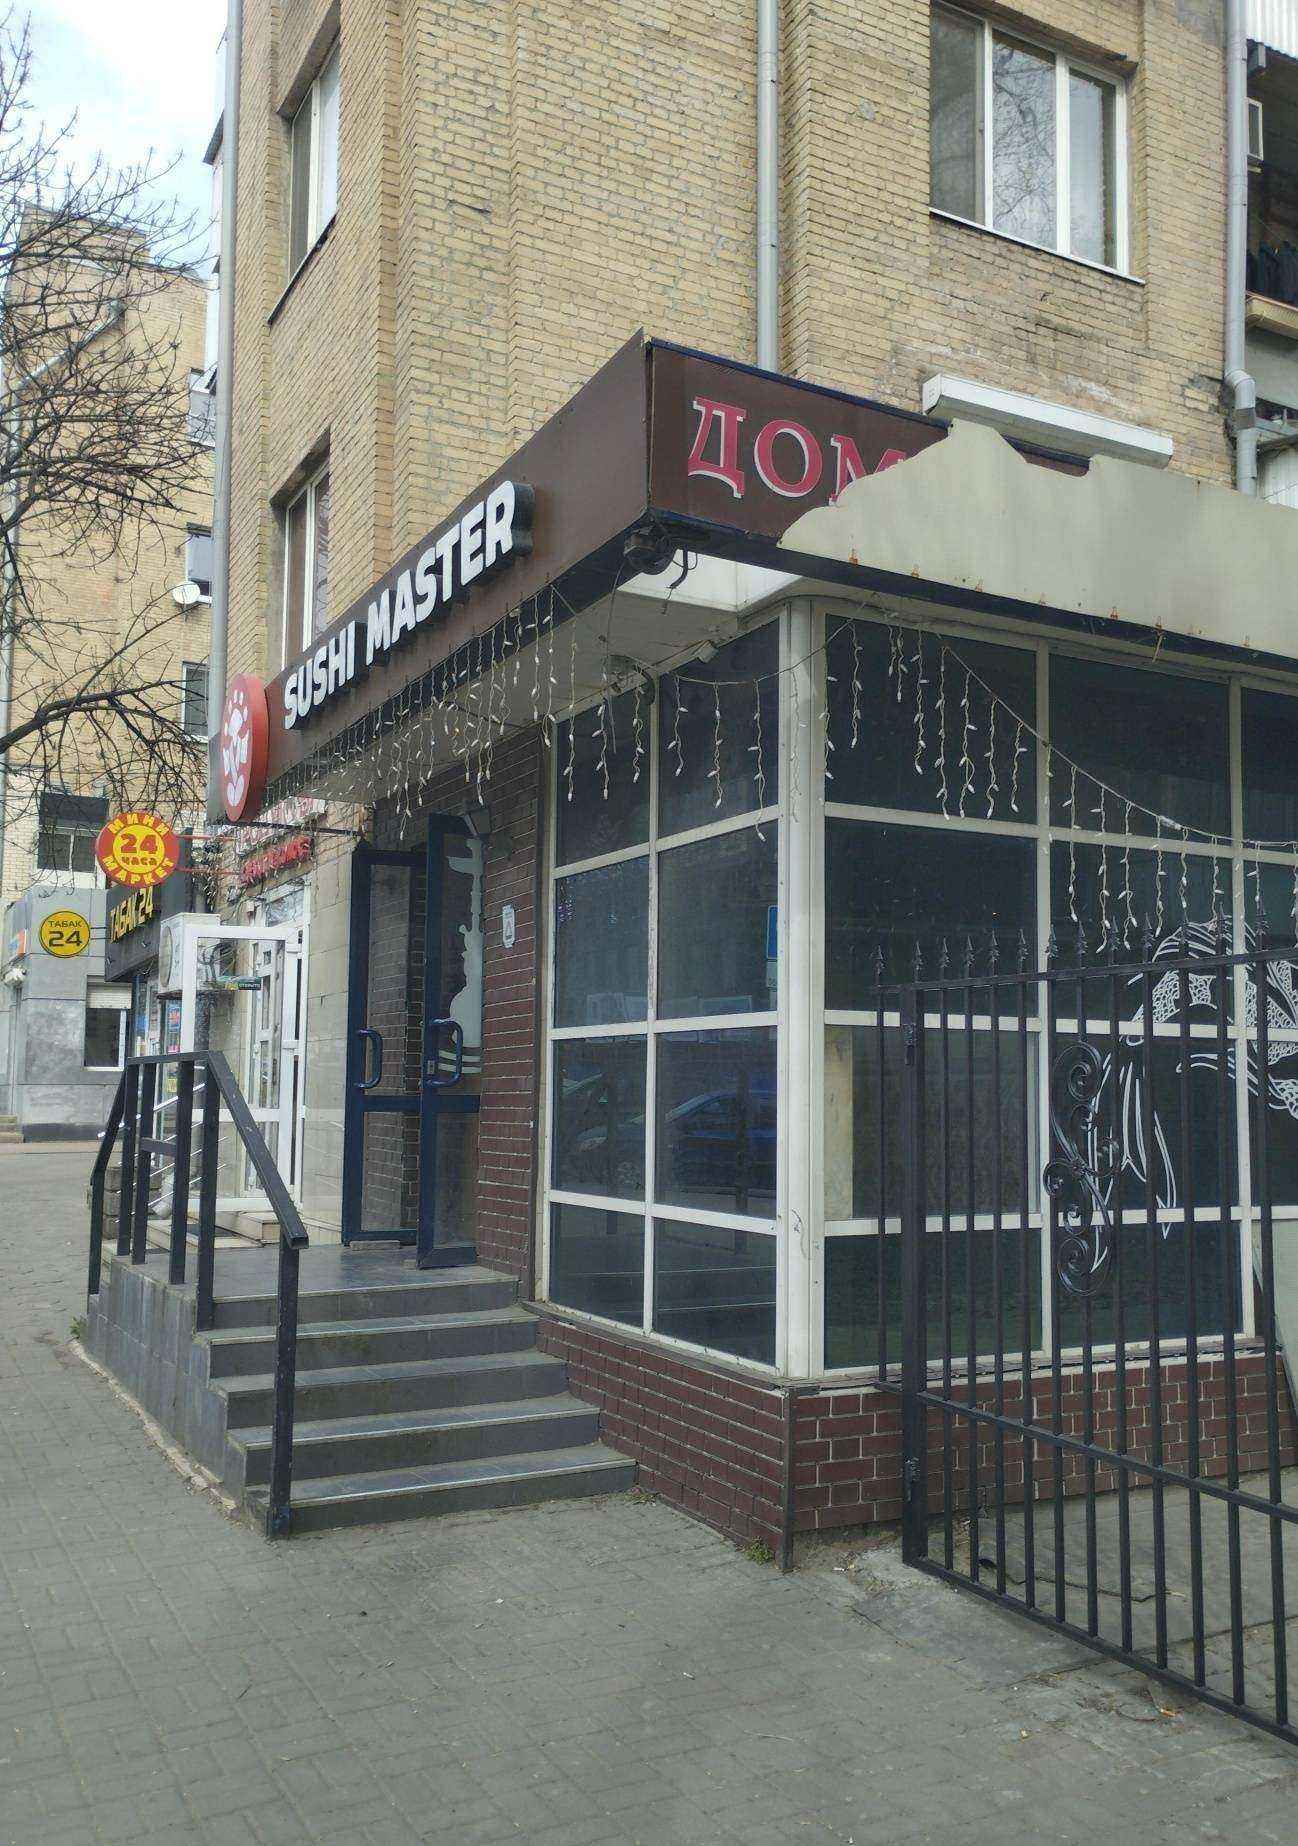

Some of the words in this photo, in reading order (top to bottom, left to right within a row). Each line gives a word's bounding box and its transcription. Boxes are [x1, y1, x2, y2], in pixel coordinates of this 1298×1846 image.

[283, 621, 356, 730] SUSHI
[366, 480, 515, 667] MASTER
[107, 813, 170, 836] МИНИ
[120, 833, 158, 854] 24
[102, 855, 175, 885] МАРКЕТ
[47, 920, 83, 928] ТАБАК
[48, 930, 83, 947] 24
